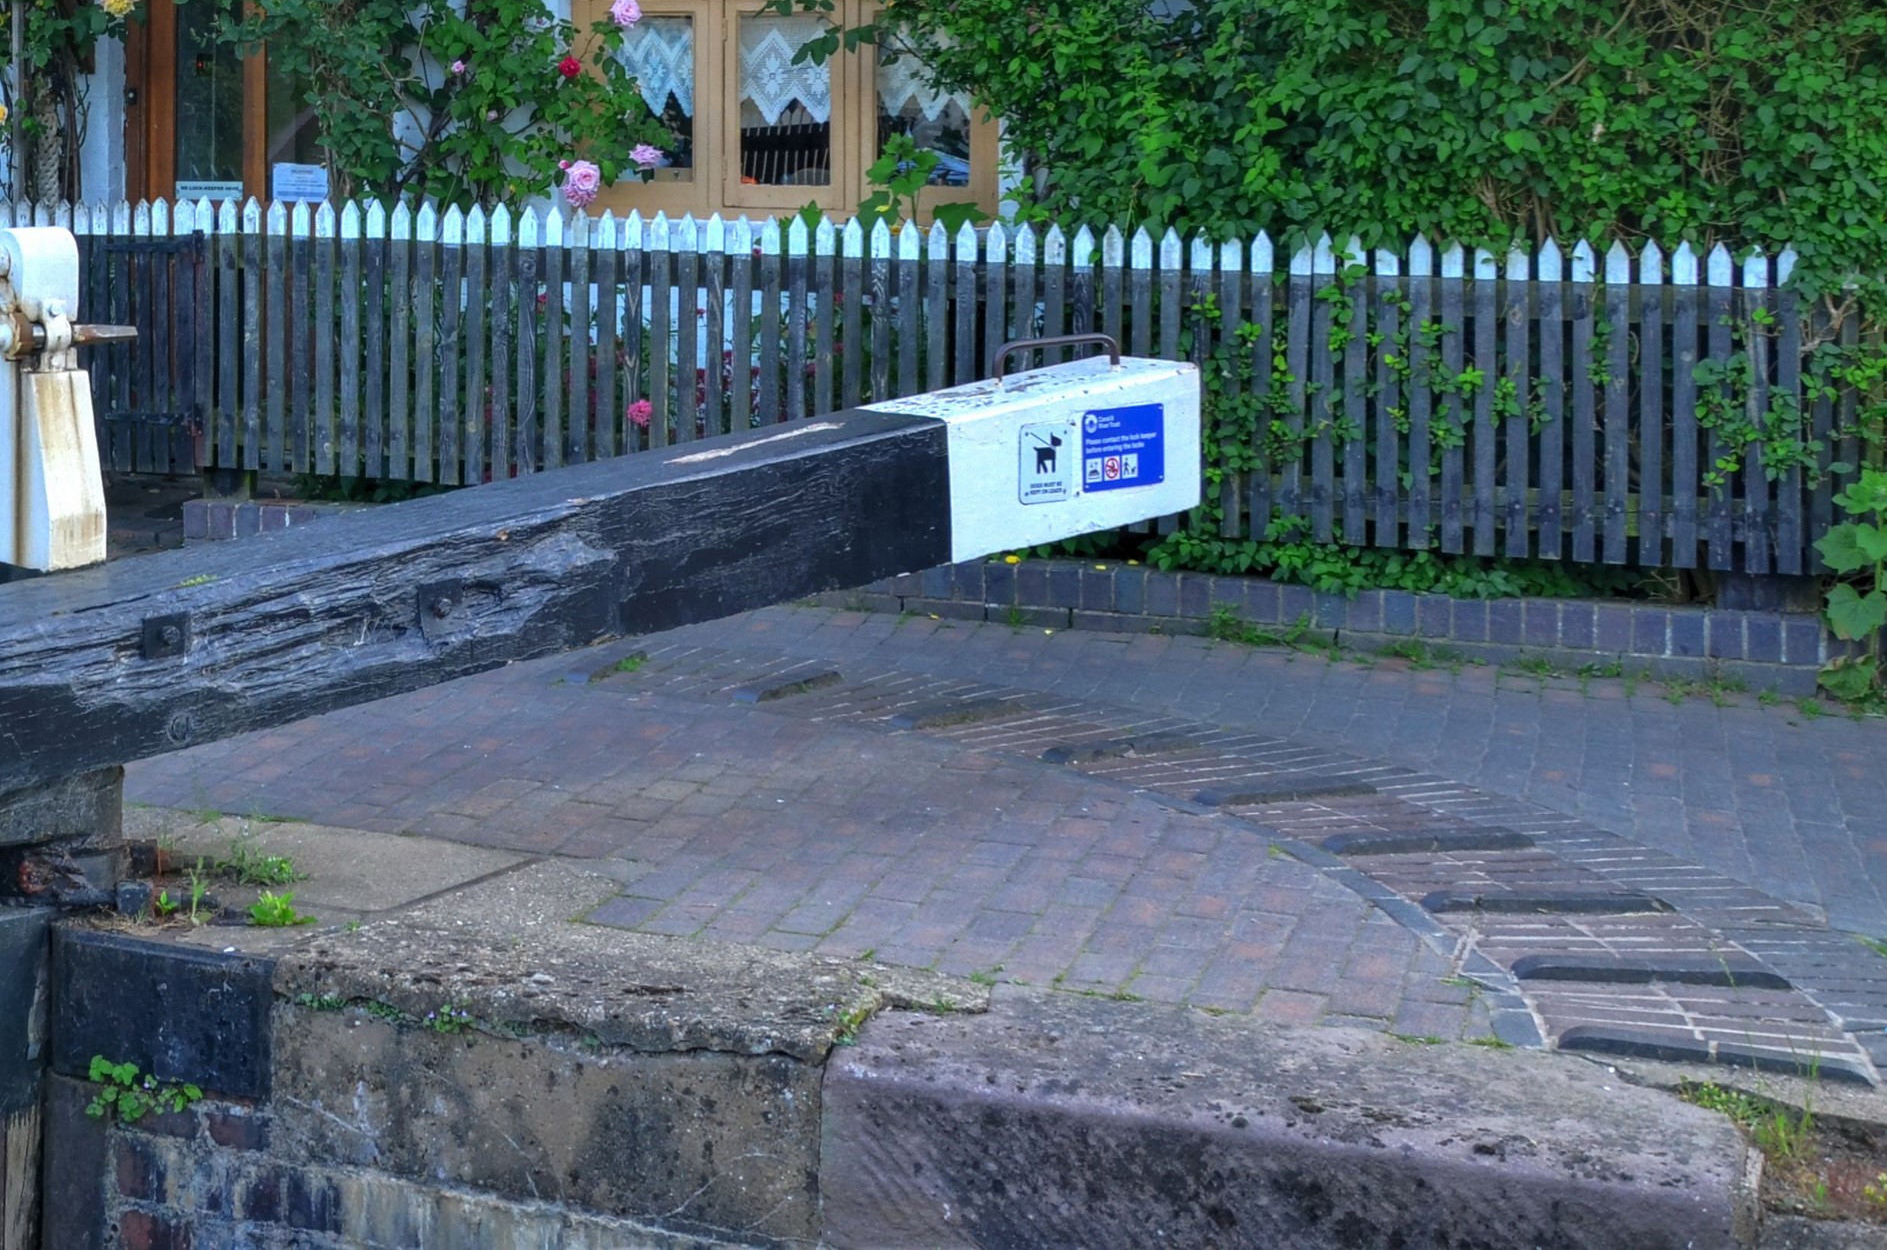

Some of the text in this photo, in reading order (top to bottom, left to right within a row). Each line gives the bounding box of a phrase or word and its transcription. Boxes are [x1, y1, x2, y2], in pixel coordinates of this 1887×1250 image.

[1085, 438, 1102, 446] Please
[1102, 436, 1121, 444] contact
[1140, 432, 1157, 440] keeper
[1085, 446, 1102, 454] before
[1103, 444, 1123, 452] entering
